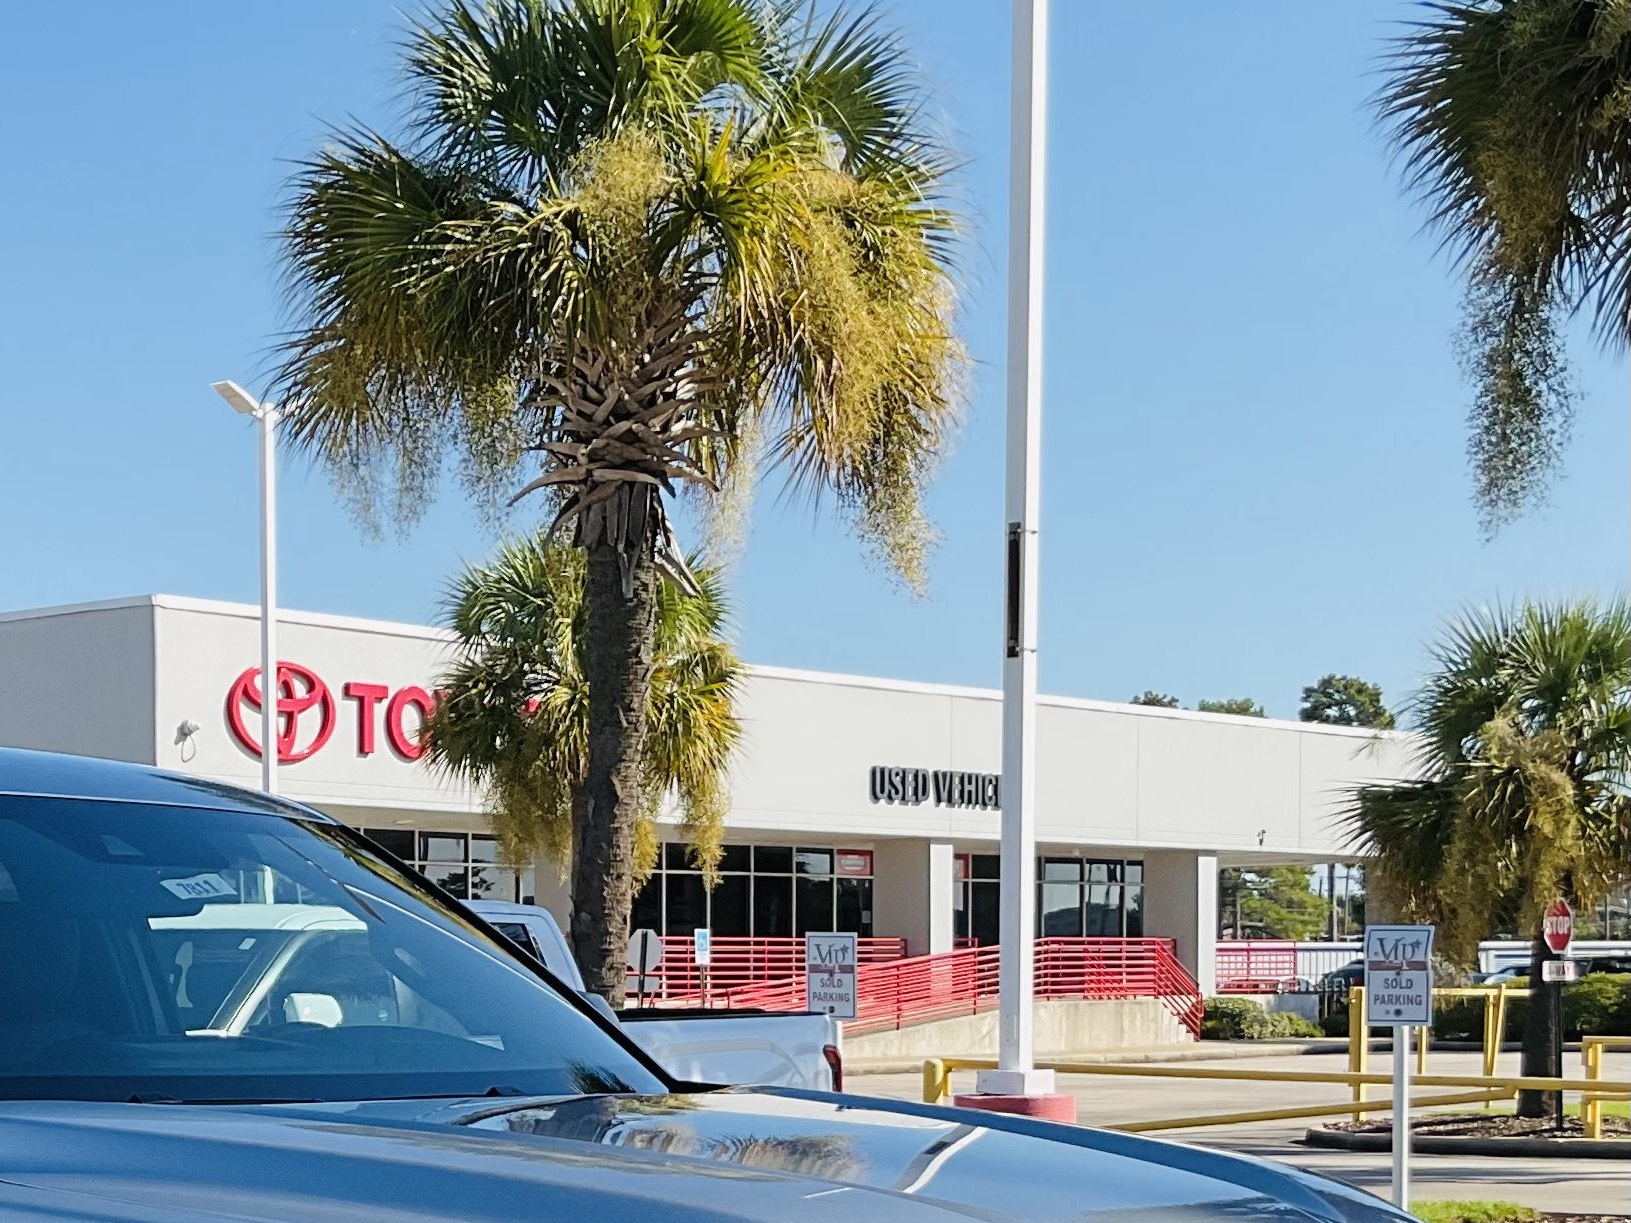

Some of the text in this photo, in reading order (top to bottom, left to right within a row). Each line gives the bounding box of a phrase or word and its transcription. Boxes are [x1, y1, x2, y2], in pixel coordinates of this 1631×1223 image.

[869, 766, 1003, 811] USED VEHIC
[1545, 915, 1570, 935] STOP
[819, 977, 843, 988] SOLD
[1383, 978, 1414, 990] SOLD
[812, 991, 850, 1003] PARKING
[1373, 993, 1423, 1006] PARKING
